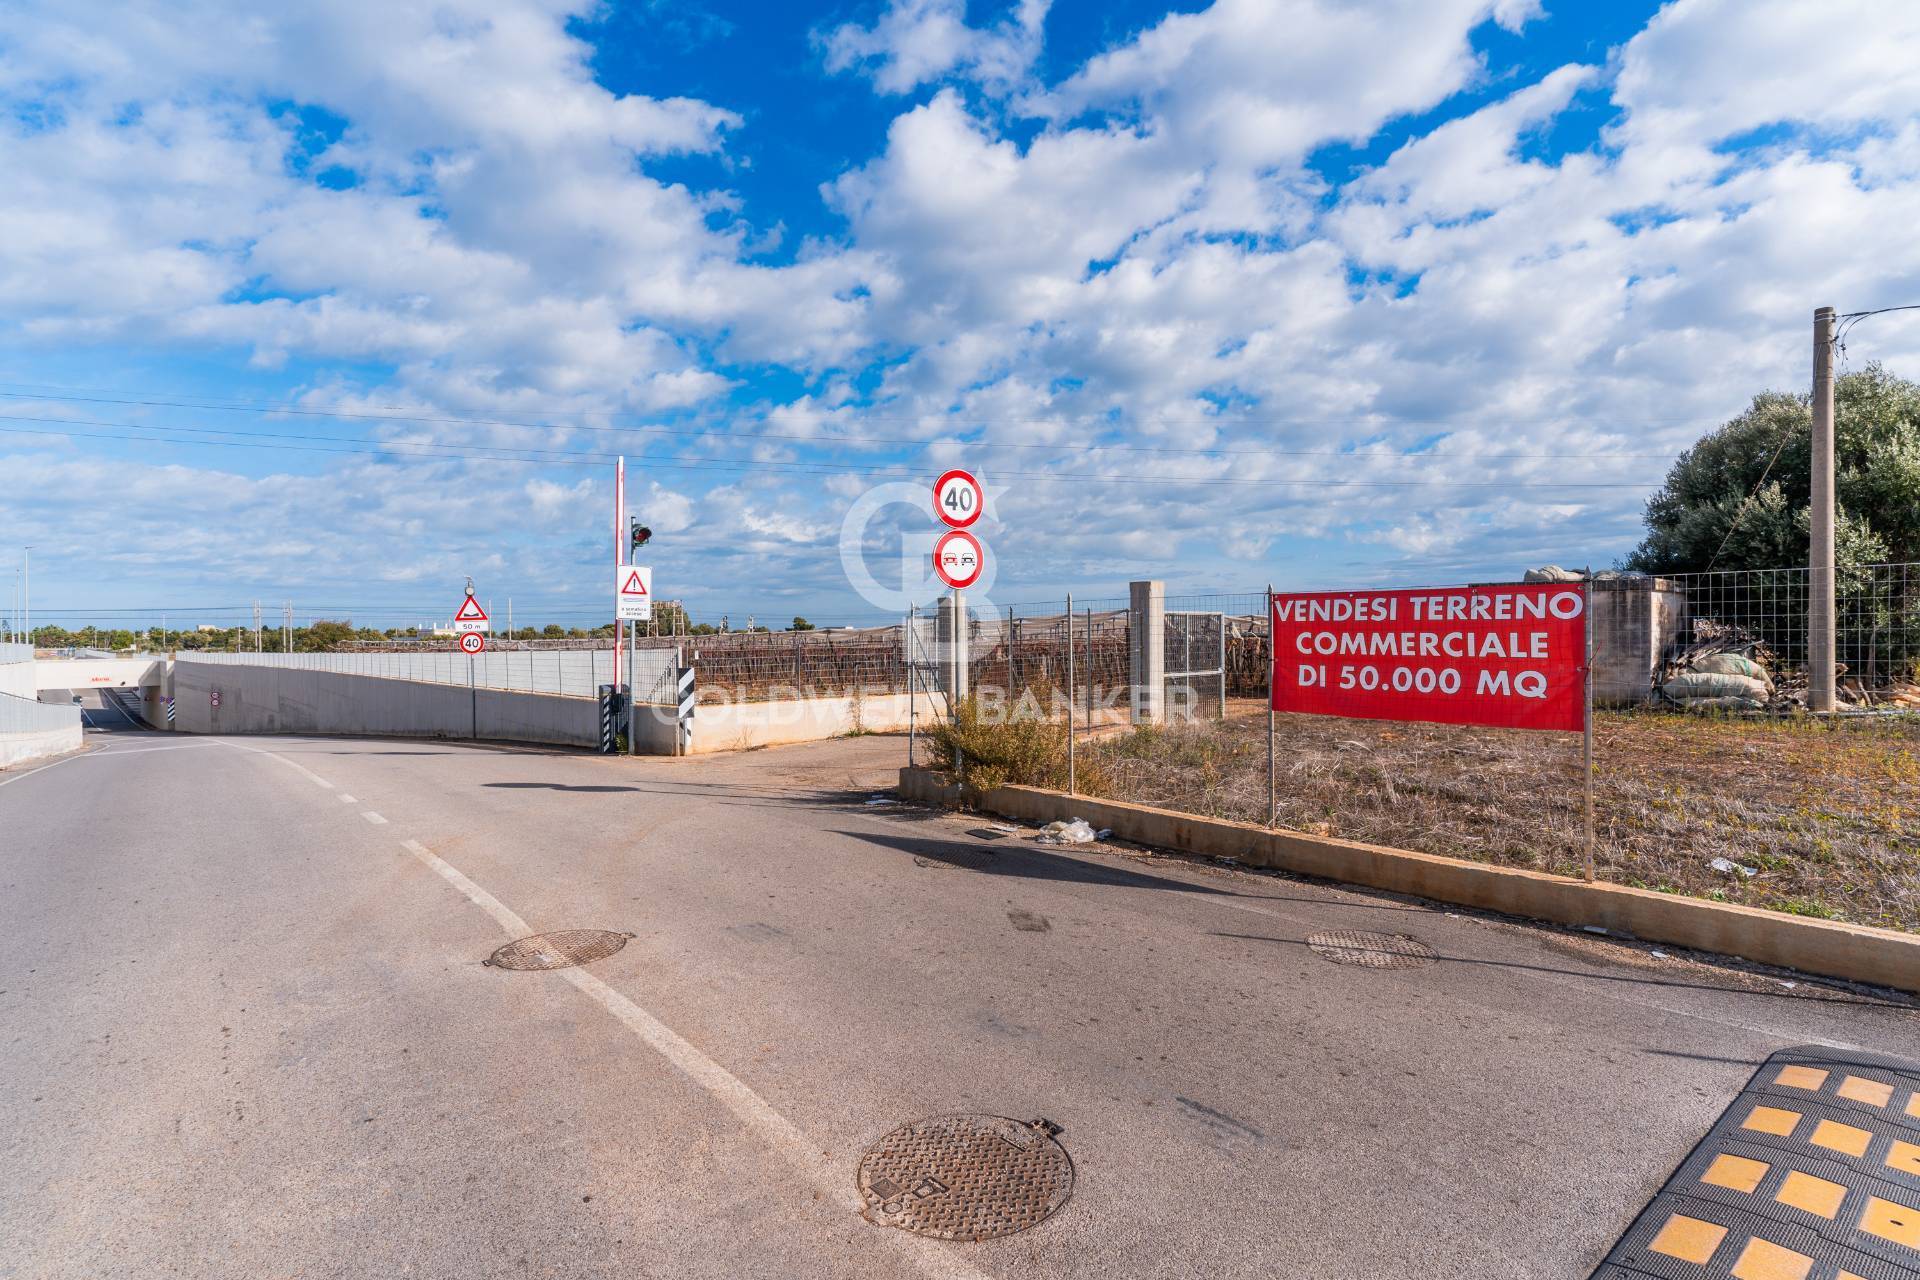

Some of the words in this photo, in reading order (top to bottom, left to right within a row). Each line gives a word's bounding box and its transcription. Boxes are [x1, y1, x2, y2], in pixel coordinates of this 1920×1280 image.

[945, 487, 972, 511] 40
[1275, 597, 1397, 622] VENDESI
[1410, 591, 1584, 620] TERRENO
[465, 638, 479, 648] 40
[1296, 631, 1549, 658] COMMERCIALE
[1298, 664, 1326, 688] DI
[1339, 665, 1461, 694] 50.000
[1476, 669, 1548, 699] MQ
